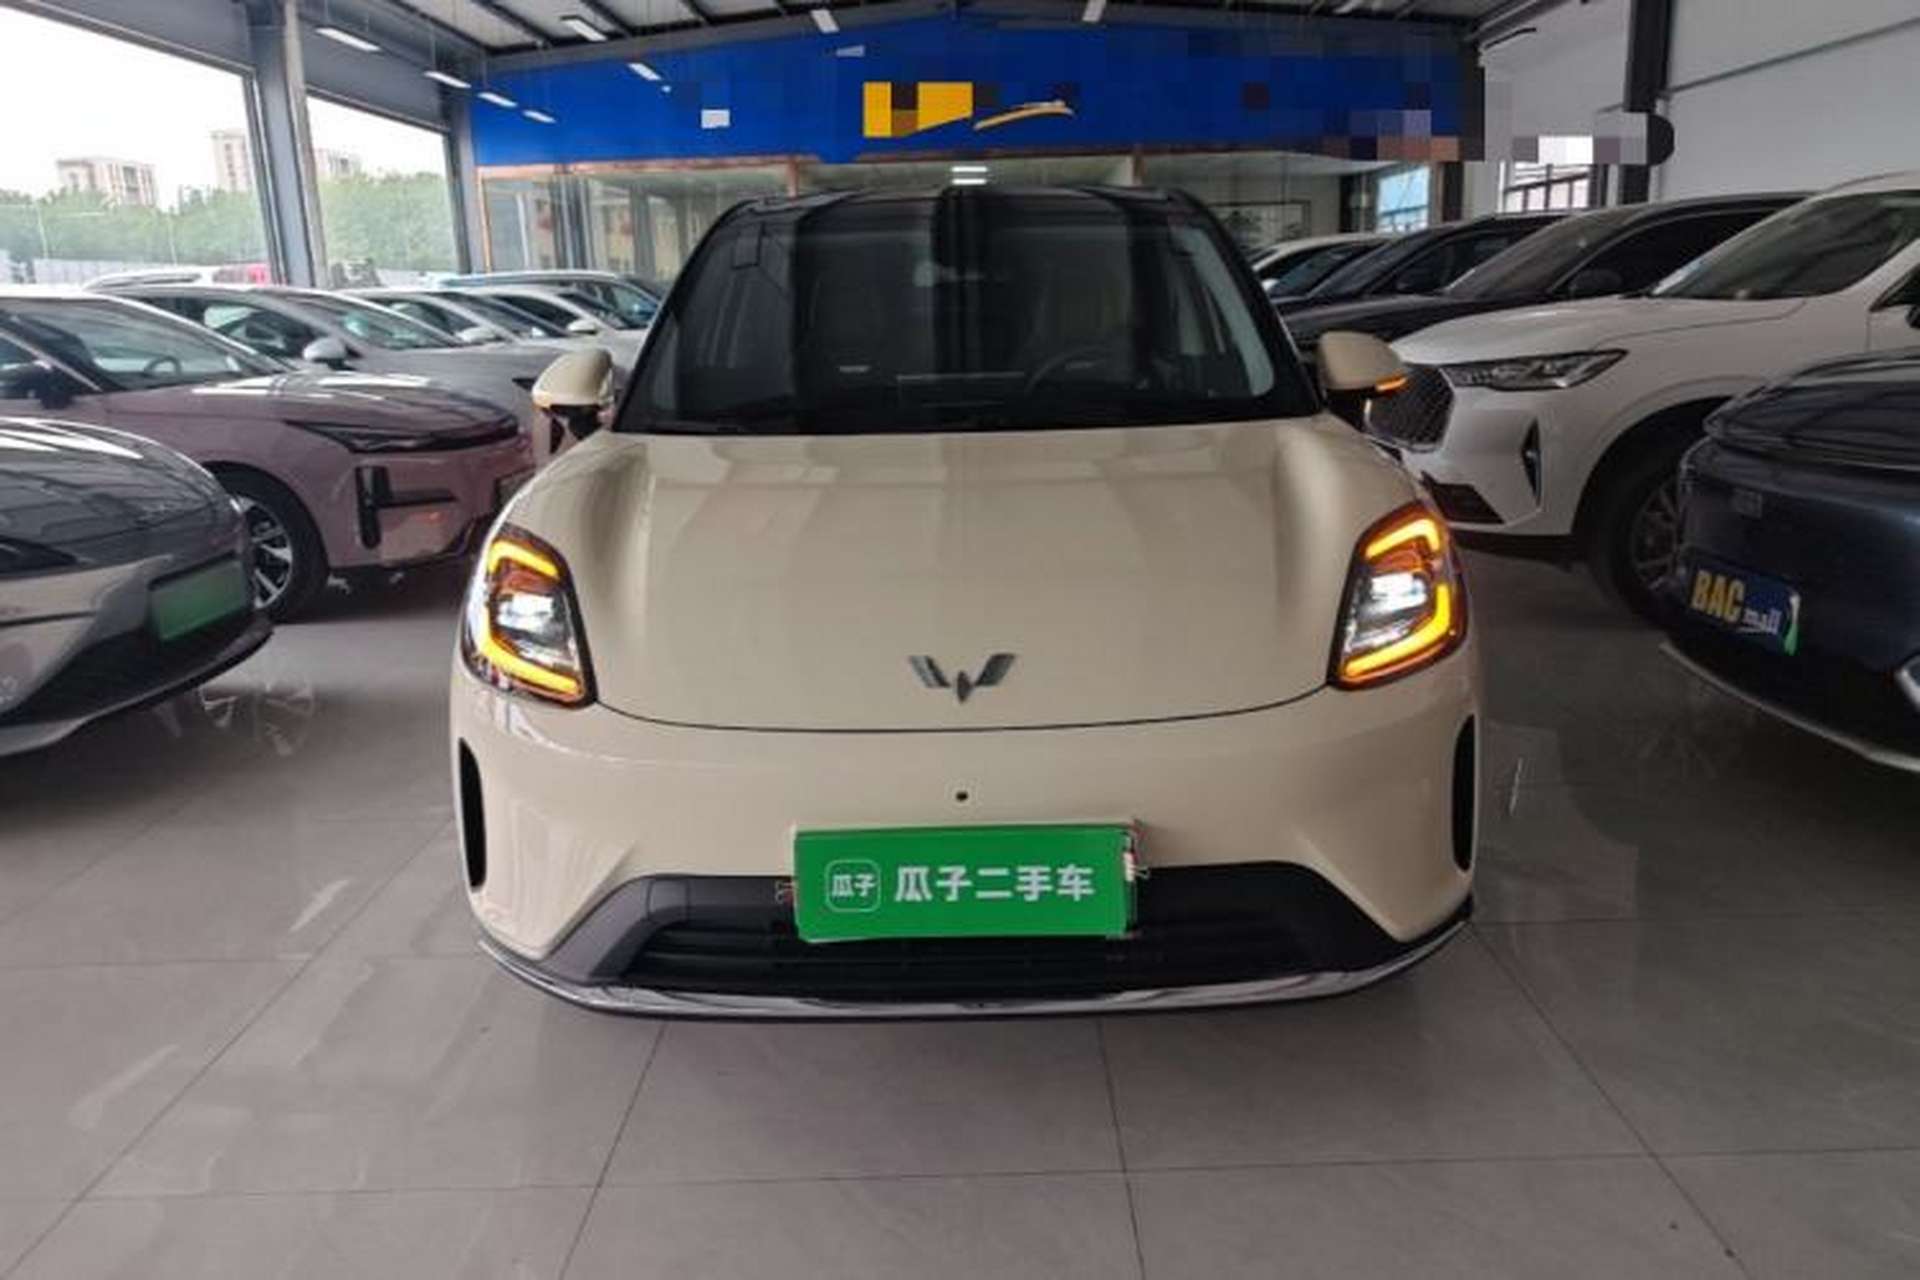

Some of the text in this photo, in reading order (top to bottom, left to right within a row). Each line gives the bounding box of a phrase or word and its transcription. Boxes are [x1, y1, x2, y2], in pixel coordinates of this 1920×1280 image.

[1690, 568, 1746, 624] BAC
[832, 873, 875, 898] 瓜子
[895, 864, 1095, 902] 瓜子二手车
